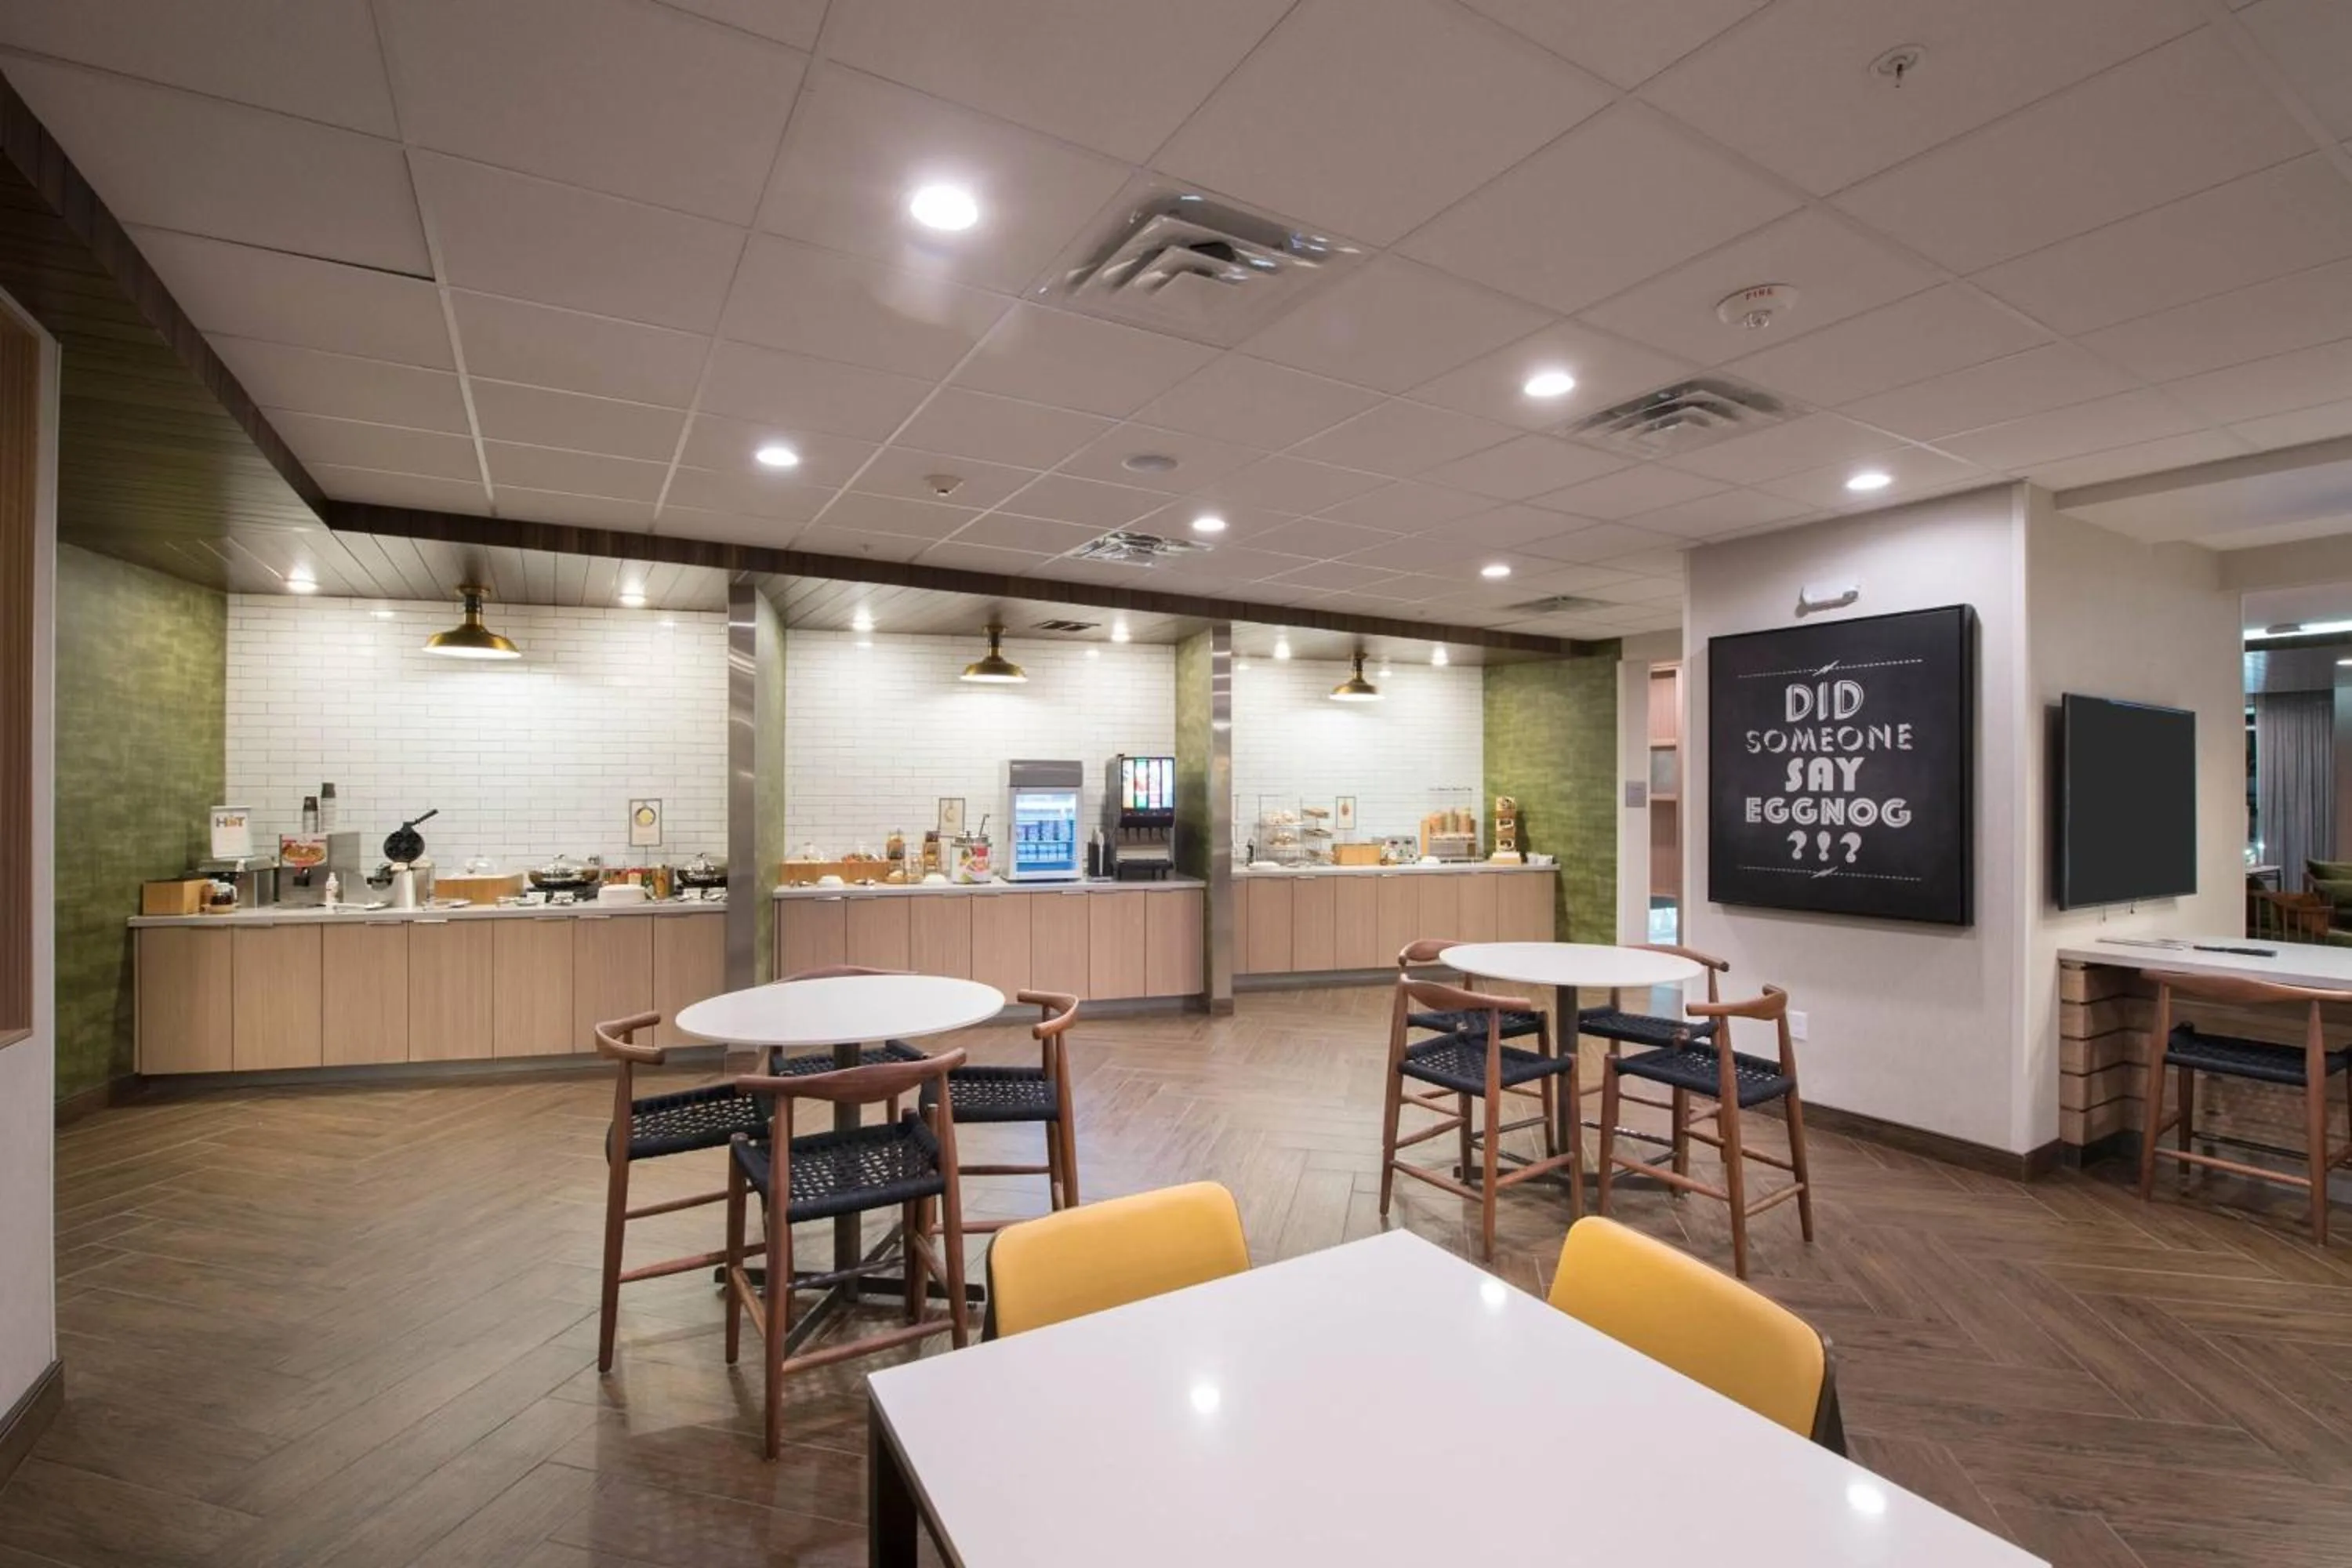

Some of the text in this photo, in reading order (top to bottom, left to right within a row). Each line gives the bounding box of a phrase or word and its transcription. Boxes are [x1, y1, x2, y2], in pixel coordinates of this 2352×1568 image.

[1745, 288, 1773, 301] FIRE
[1785, 680, 1864, 722] DID
[1746, 723, 1914, 753] SOMEONE
[1785, 757, 1865, 793] SAY
[1745, 797, 1912, 829] EGGNOG
